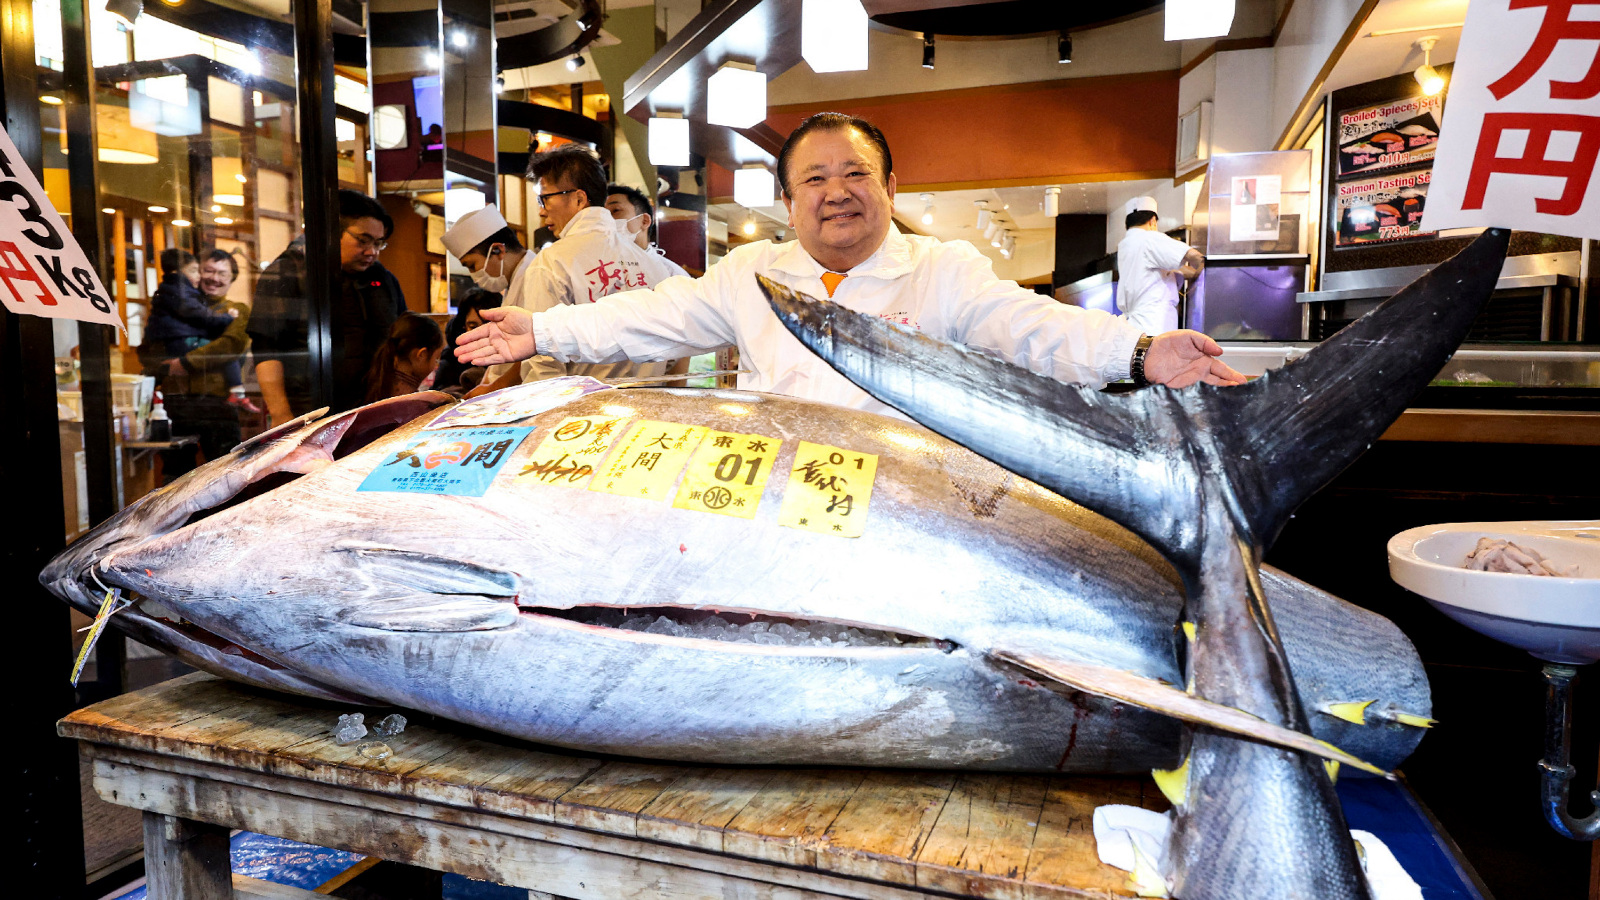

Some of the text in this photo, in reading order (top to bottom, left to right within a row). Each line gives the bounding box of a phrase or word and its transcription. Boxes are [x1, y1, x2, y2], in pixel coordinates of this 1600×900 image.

[1343, 96, 1438, 125] Broiled 3pieces Set
[1378, 152, 1410, 165] 910円
[1340, 174, 1432, 196] Salmon Tasting Se
[1378, 225, 1410, 239] 773円
[35, 255, 110, 314] Kg
[631, 431, 673, 472] 大間
[714, 453, 764, 486] 01
